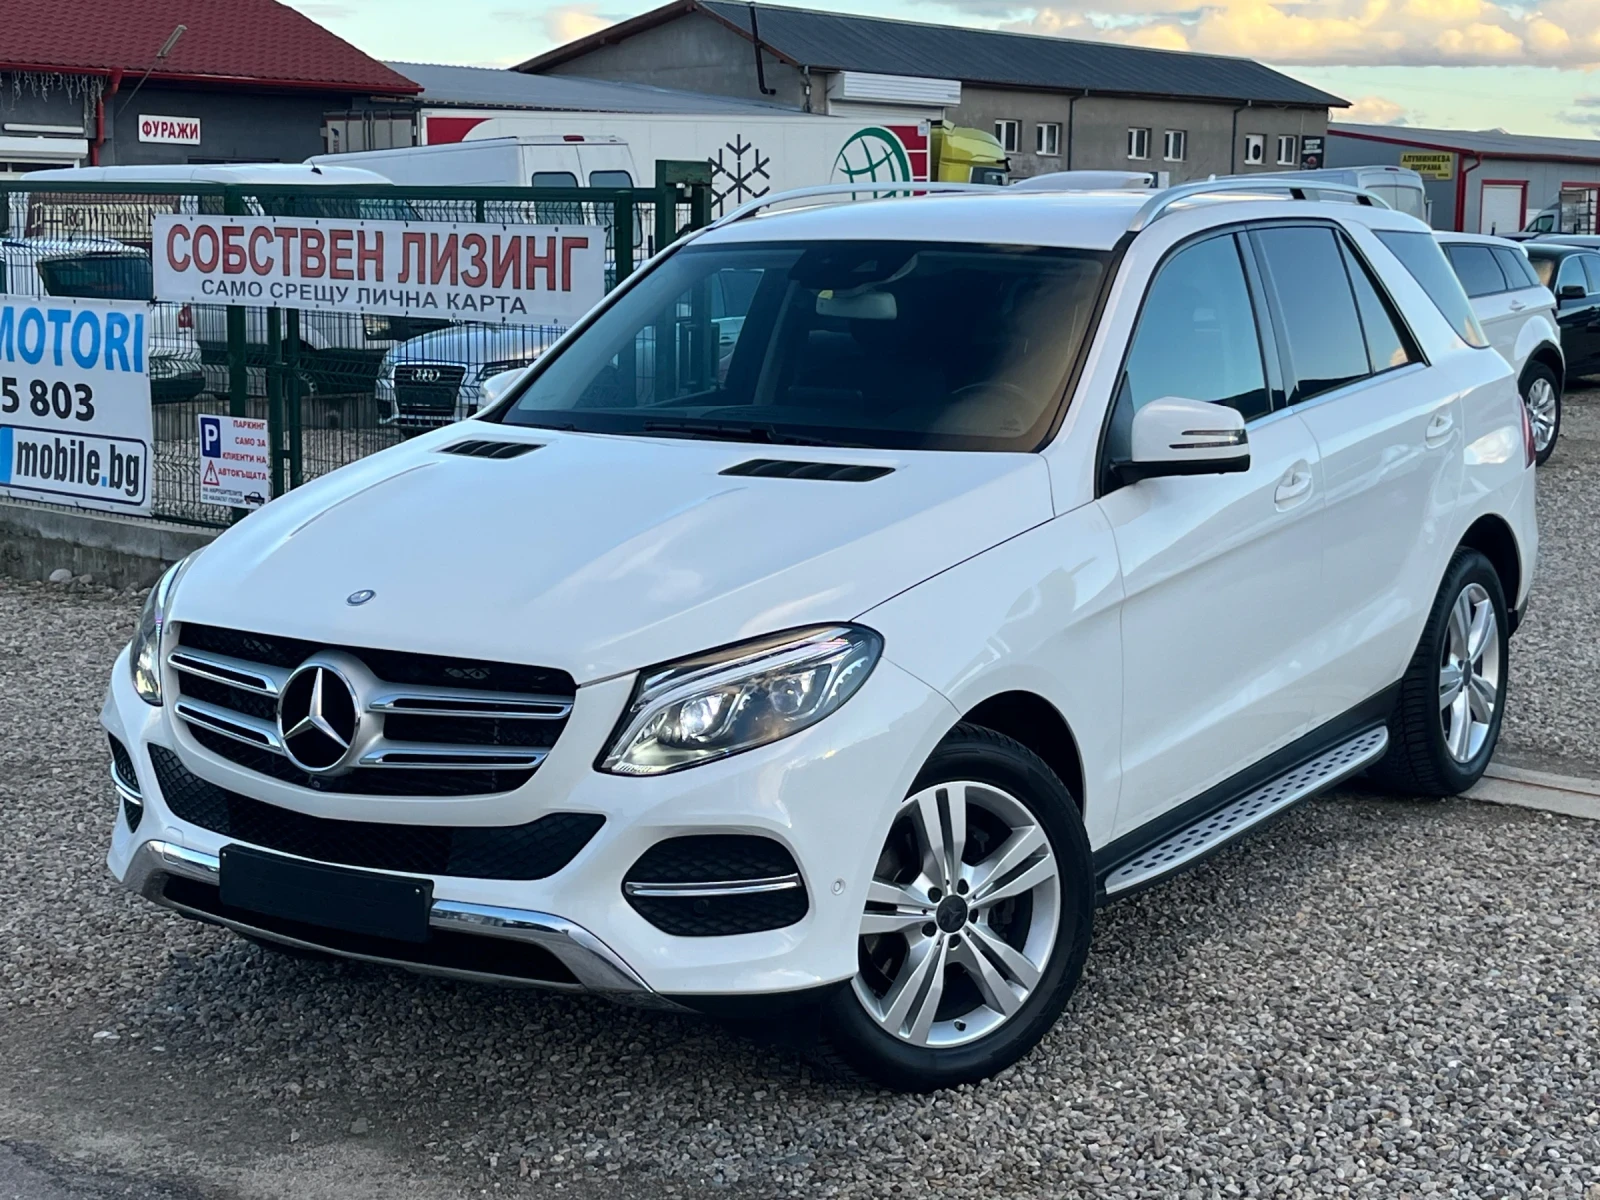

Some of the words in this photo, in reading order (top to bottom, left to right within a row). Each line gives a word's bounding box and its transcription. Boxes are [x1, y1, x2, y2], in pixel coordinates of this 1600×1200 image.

[142, 120, 199, 139] ФУРАЖИ
[166, 223, 385, 282] СОБСТВЕН
[398, 231, 589, 292] ЛИЗИНГ
[201, 279, 263, 297] САМО
[269, 282, 349, 304] СРЕЩУ
[356, 287, 439, 309] ЛИЧНА
[446, 292, 528, 315] КАРТА
[1, 376, 20, 413] 5
[29, 379, 95, 422] 803
[233, 420, 266, 430] ПАРКИНГ
[235, 436, 255, 446] САМО
[257, 439, 266, 447] ЗА
[15, 437, 141, 497] mobile.bg
[222, 452, 255, 463] КЛИЕНТИ
[218, 467, 267, 481] АВТОКЪЩАТА
